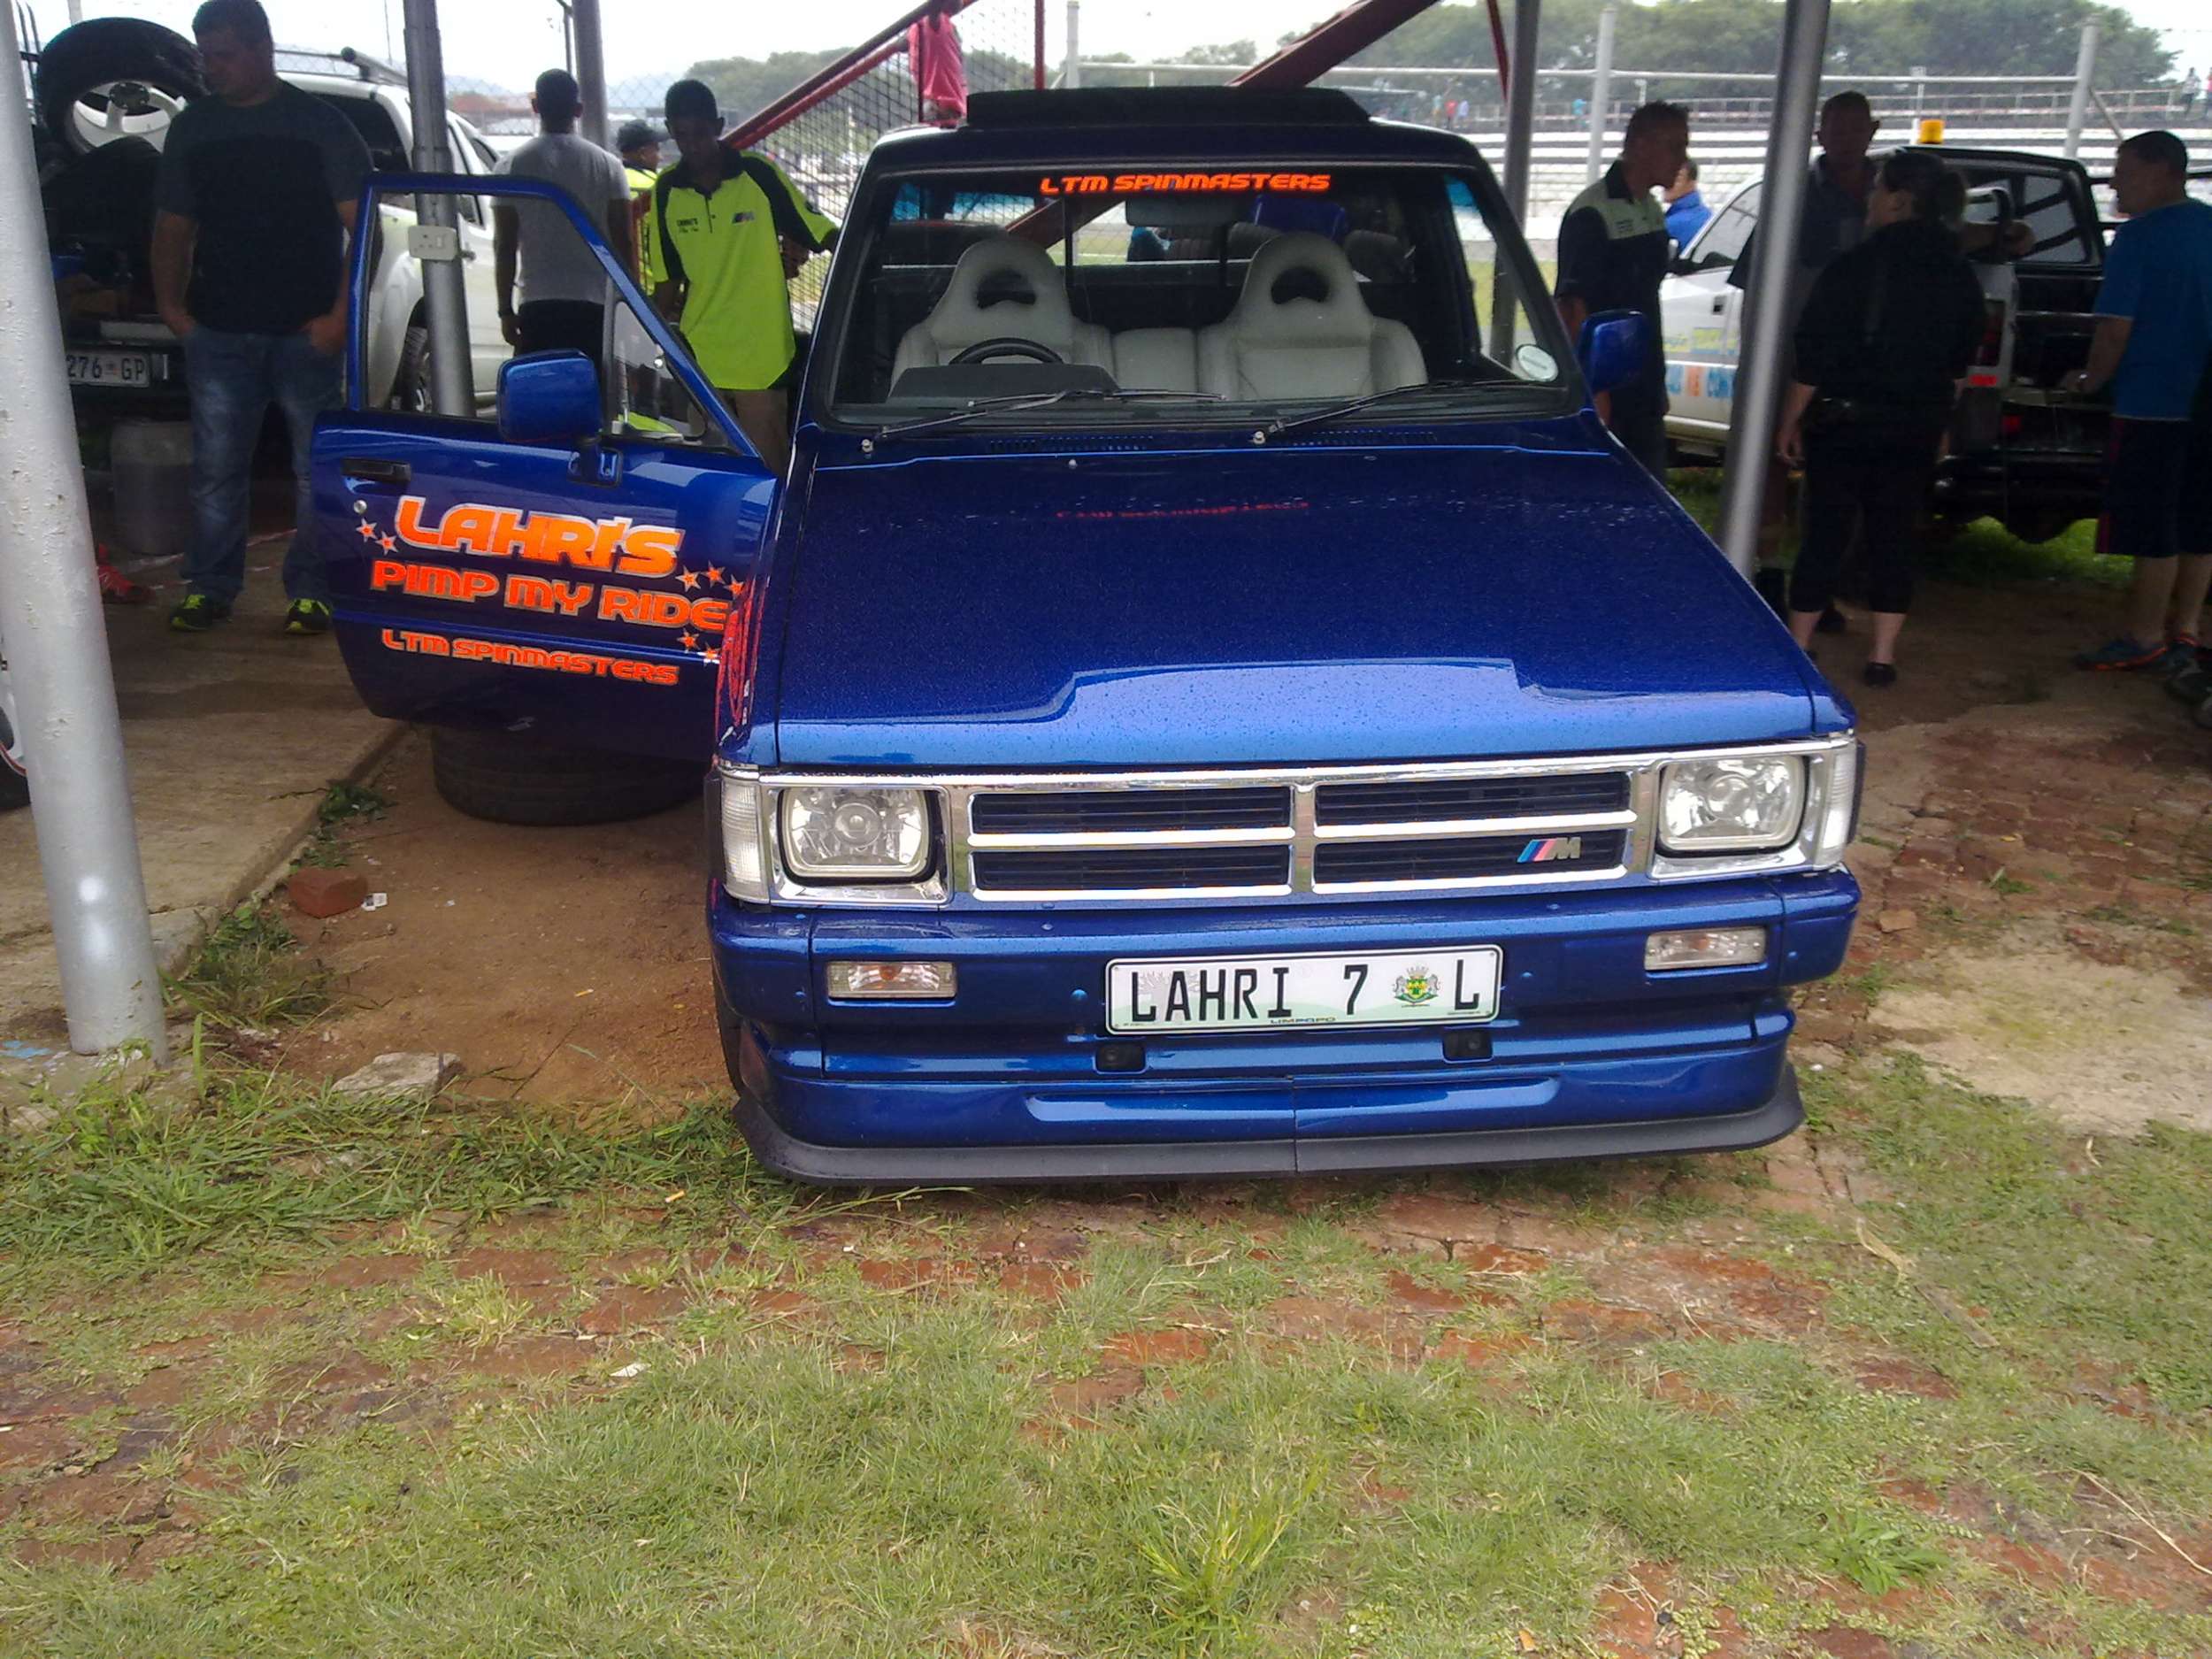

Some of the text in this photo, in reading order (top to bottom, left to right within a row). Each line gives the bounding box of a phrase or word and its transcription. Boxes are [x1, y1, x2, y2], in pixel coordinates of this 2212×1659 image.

[1040, 173, 1332, 194] LTM SPINMASTERS
[66, 355, 144, 380] 276 GP
[370, 558, 732, 632] PIMP MY RIDE
[381, 628, 680, 686] LTM SPINMASTERS
[1131, 959, 1479, 1022] LAHRI 7 L
